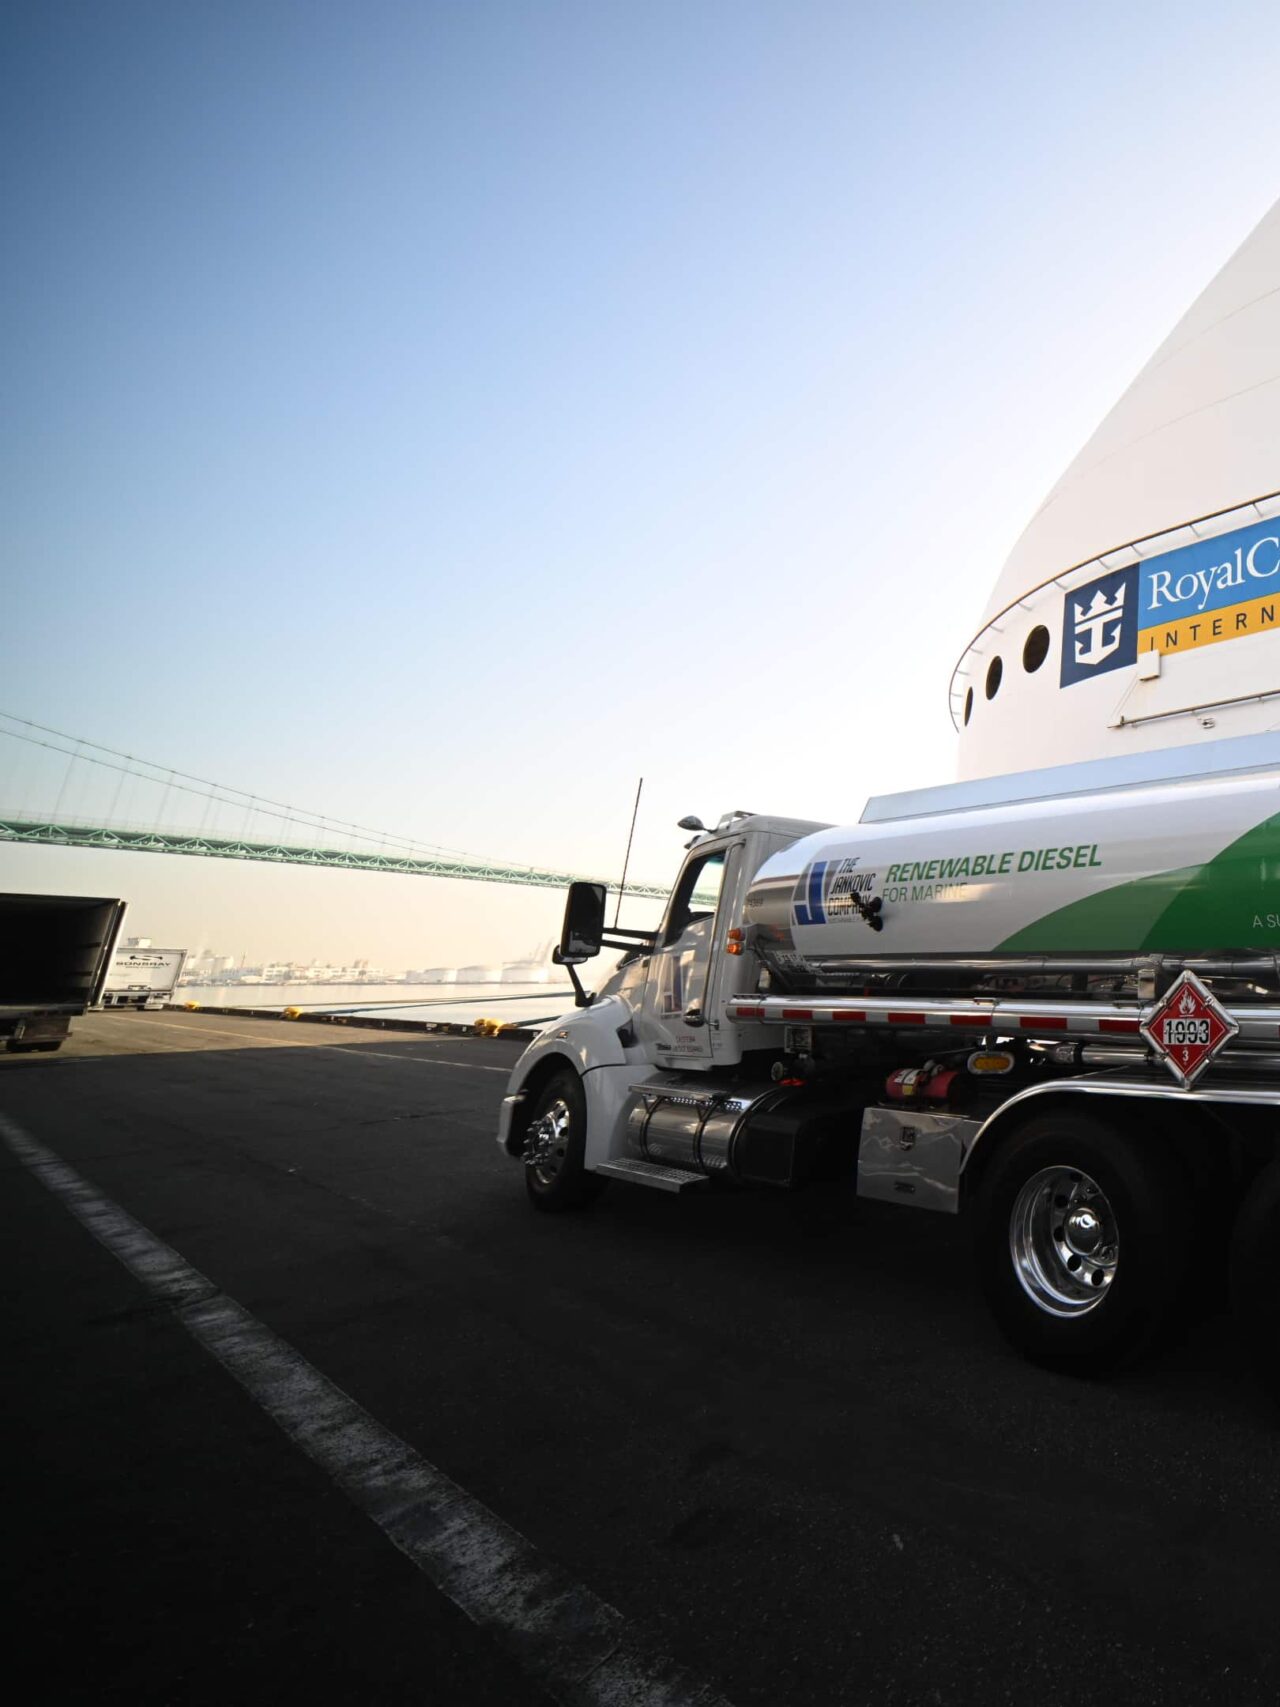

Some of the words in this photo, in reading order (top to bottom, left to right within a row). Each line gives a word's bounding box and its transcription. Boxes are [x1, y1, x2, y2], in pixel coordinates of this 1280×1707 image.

[885, 852, 1014, 883] RENEWABLE
[1017, 844, 1103, 873] DIESEL
[831, 873, 876, 895] JANKOVIC
[882, 887, 908, 902] FOR
[911, 882, 968, 901] MARINE
[1252, 914, 1263, 928] A
[1166, 1020, 1209, 1043] 1993
[1182, 1049, 1189, 1062] 3
